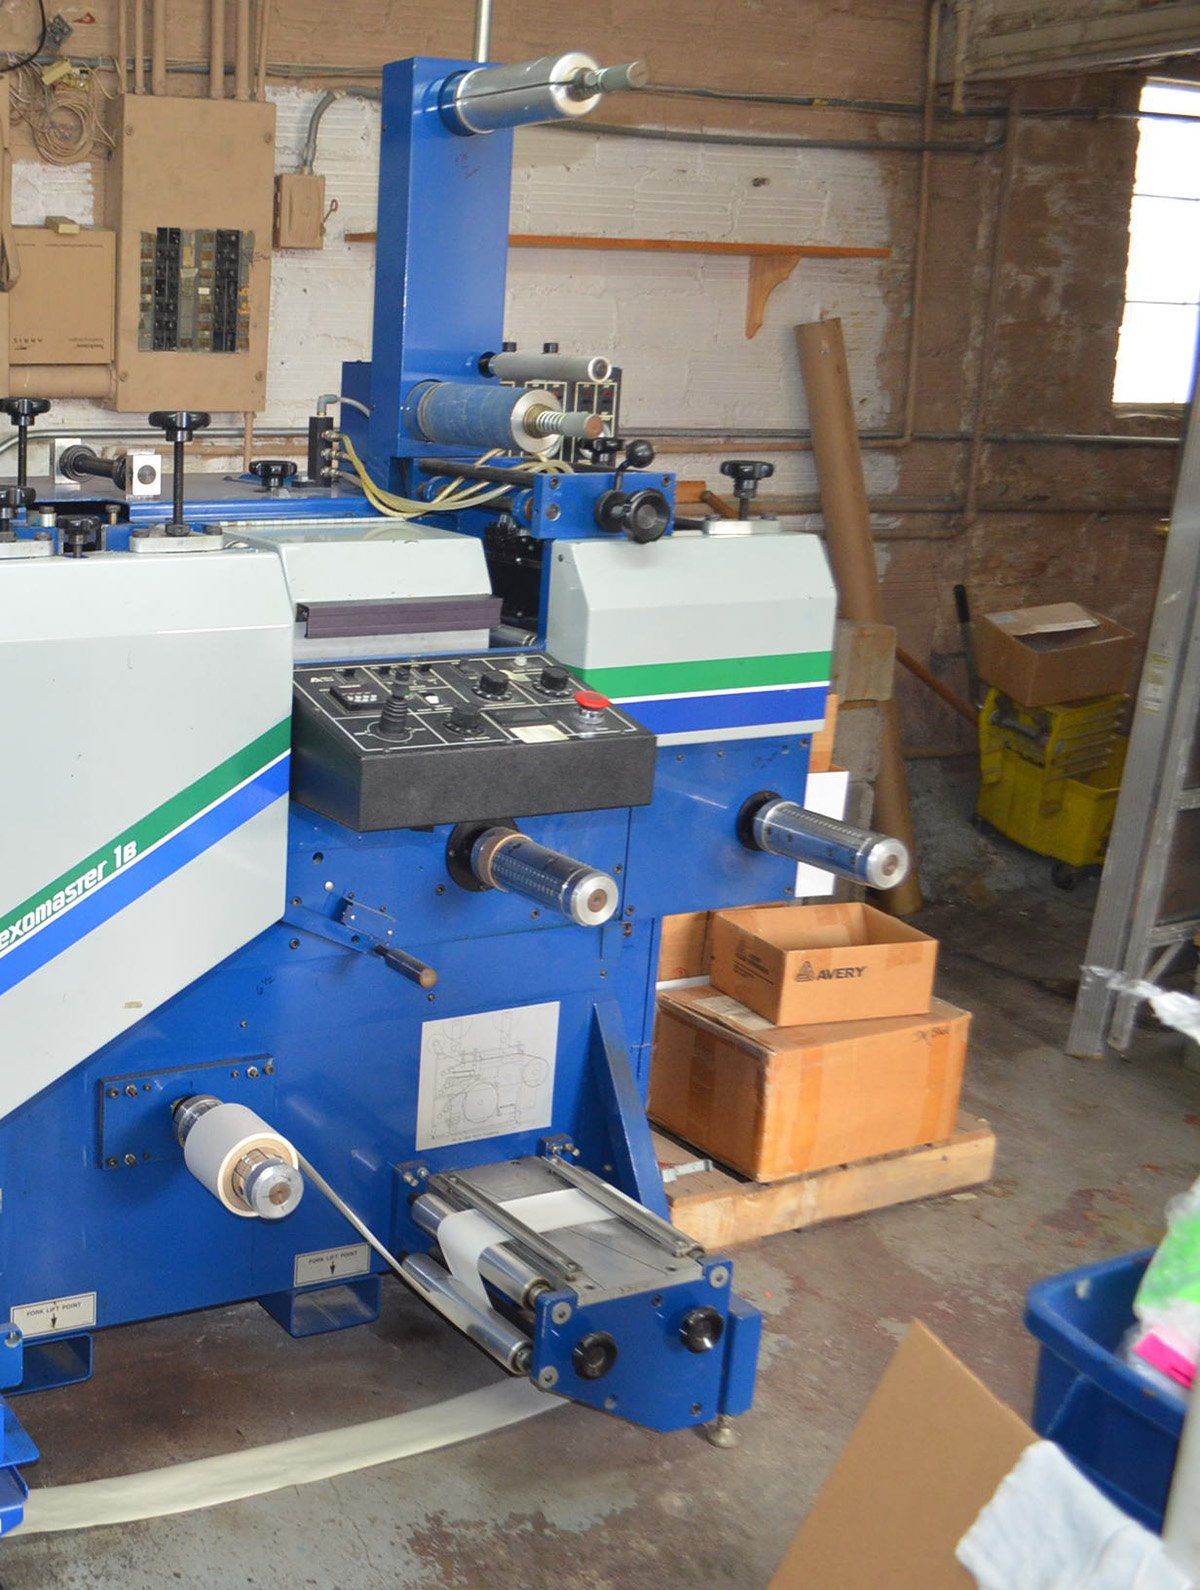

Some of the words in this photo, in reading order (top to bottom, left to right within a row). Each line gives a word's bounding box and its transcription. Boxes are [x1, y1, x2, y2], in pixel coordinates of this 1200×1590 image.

[113, 840, 138, 869] 1B
[816, 966, 869, 981] AVERY
[340, 1250, 358, 1259] POINT
[26, 1309, 43, 1317] FORK
[46, 1305, 60, 1313] LIFT
[62, 1301, 83, 1310] POINT
